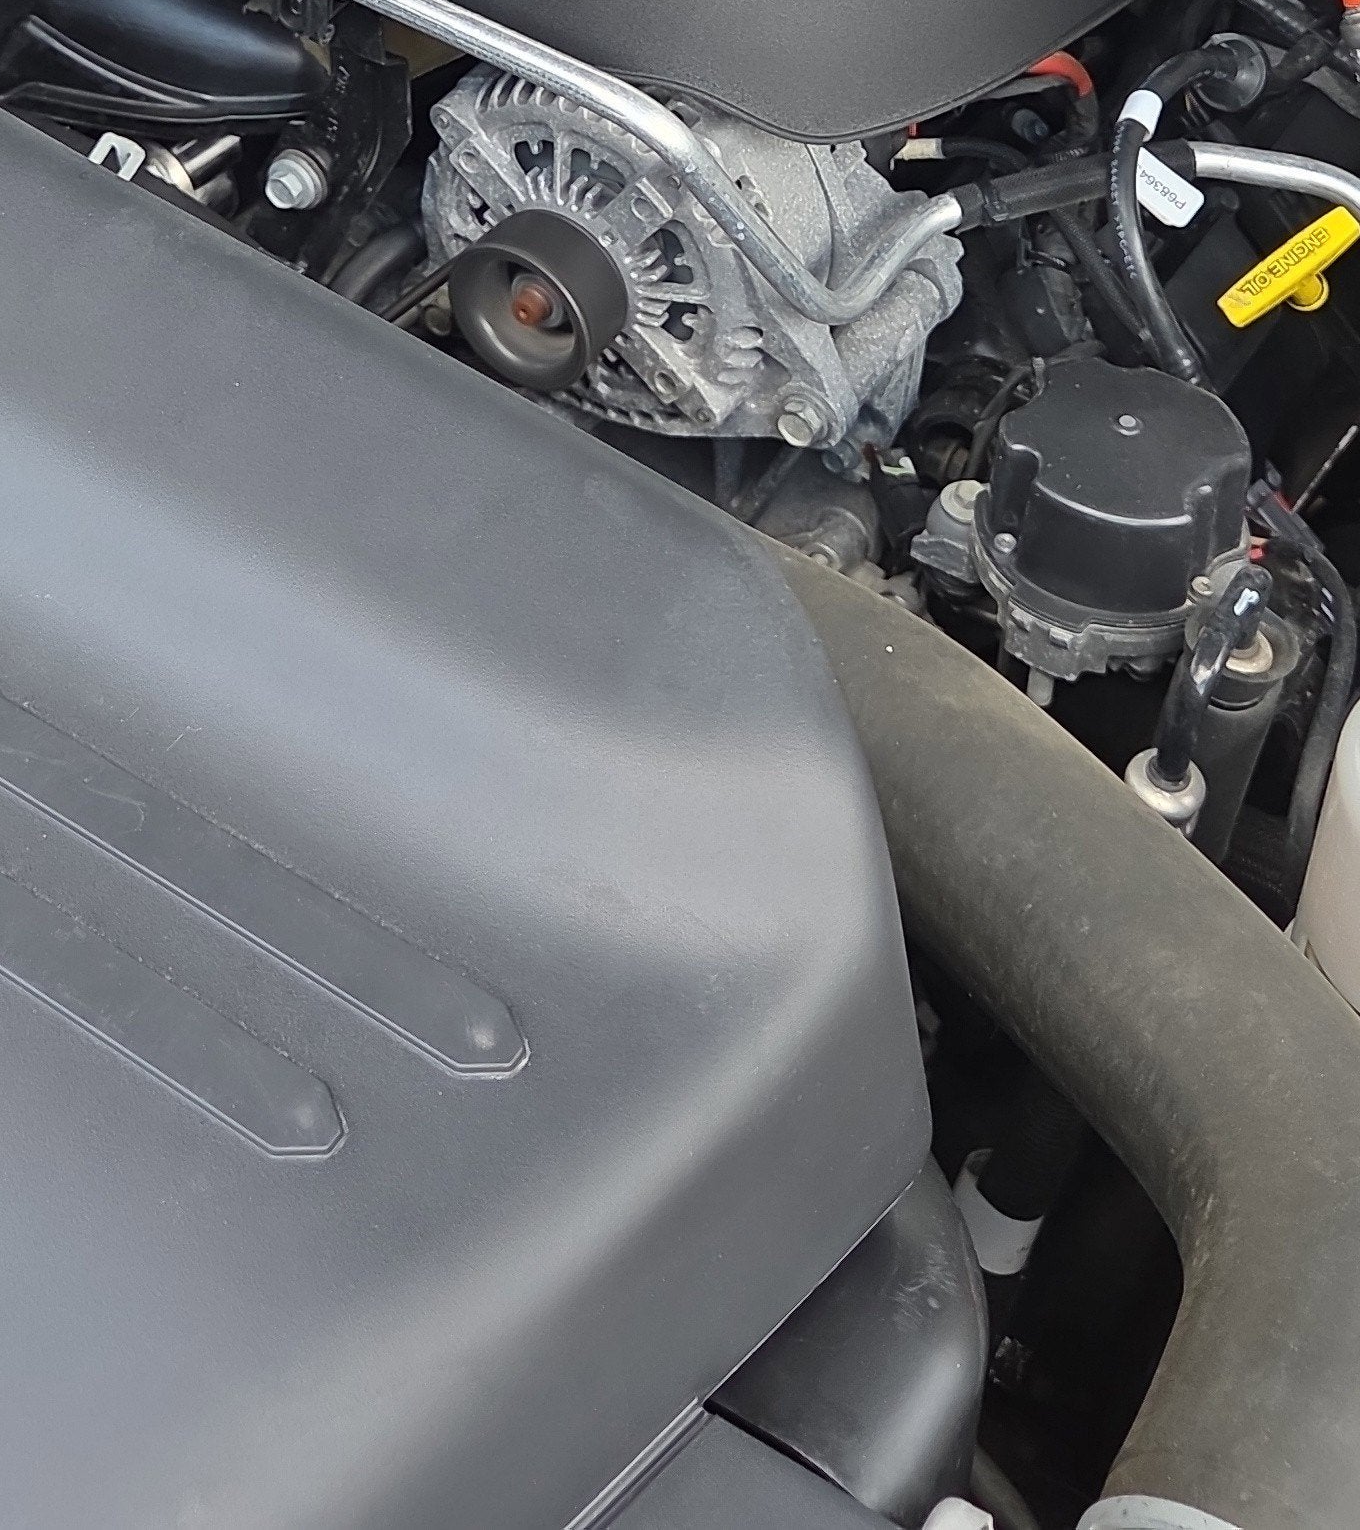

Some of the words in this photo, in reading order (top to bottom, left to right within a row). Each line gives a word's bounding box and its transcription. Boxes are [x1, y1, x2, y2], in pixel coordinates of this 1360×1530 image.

[1137, 164, 1188, 211] P68364
[1267, 226, 1331, 278] ENGINE
[1236, 274, 1272, 298] OIL
